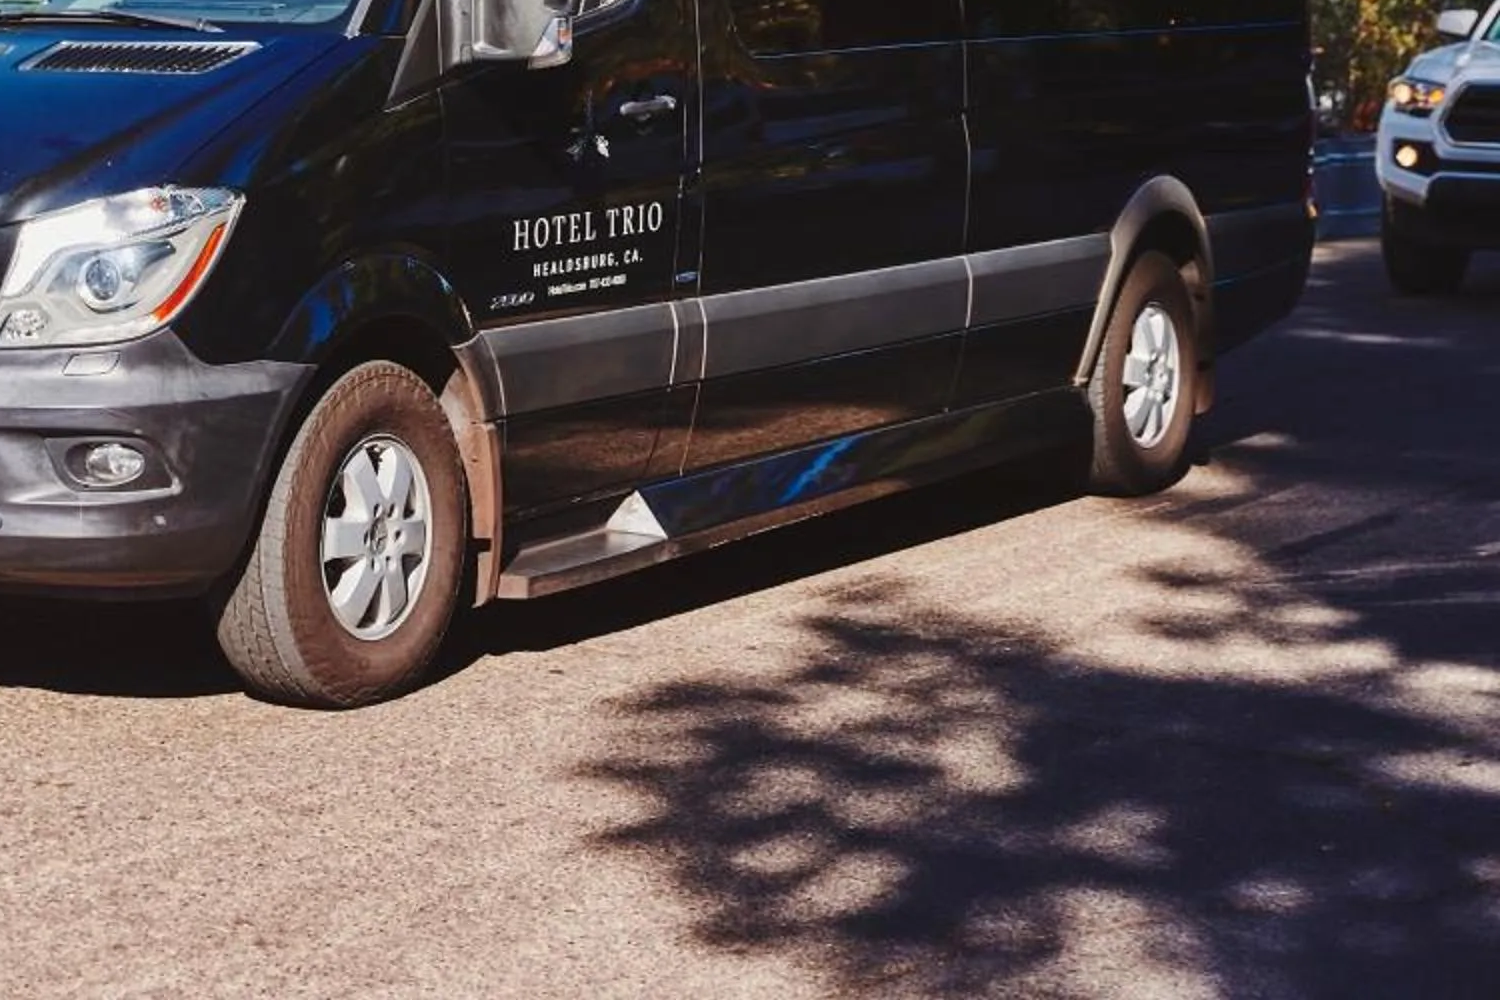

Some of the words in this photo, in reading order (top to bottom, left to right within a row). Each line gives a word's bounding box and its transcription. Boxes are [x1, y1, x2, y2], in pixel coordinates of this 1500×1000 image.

[513, 210, 597, 251] HOTEL
[605, 201, 664, 239] TRIO
[623, 248, 645, 266] CA.
